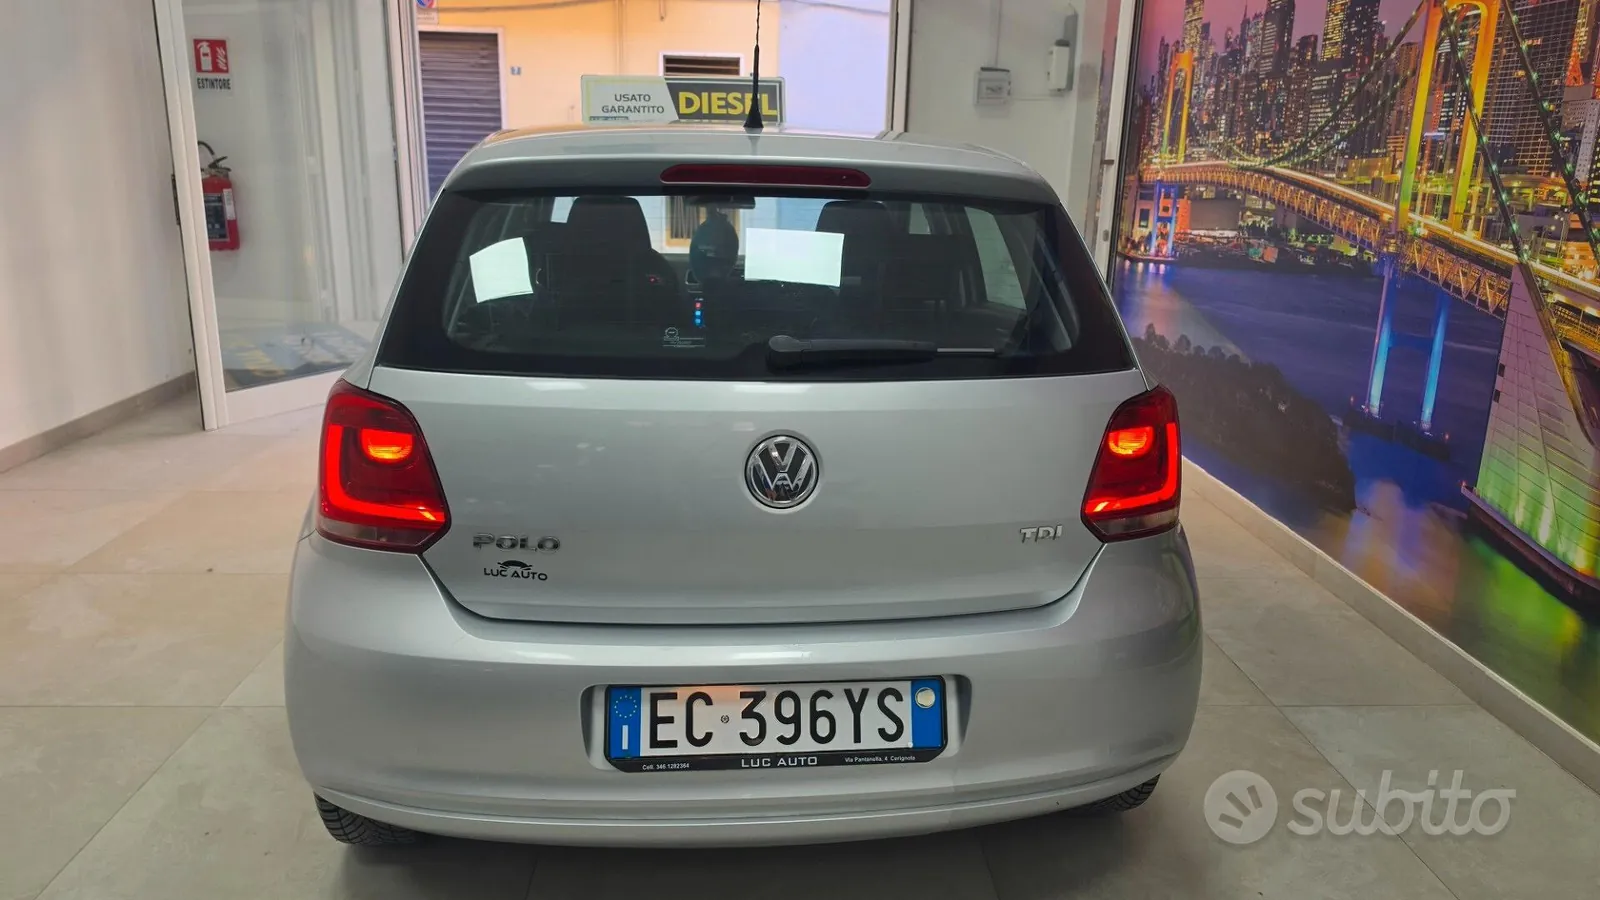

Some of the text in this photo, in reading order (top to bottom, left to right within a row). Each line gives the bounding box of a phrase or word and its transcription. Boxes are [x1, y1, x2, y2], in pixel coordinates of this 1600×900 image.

[196, 77, 231, 90] ESTINTORE
[614, 93, 651, 102] USATO
[601, 105, 665, 114] GARANTITO
[1020, 525, 1063, 543] TDI
[473, 533, 560, 552] POLO
[483, 567, 548, 581] LUC AUTO
[649, 687, 904, 749] EC 396YS
[741, 756, 818, 768] LUC AUTO
